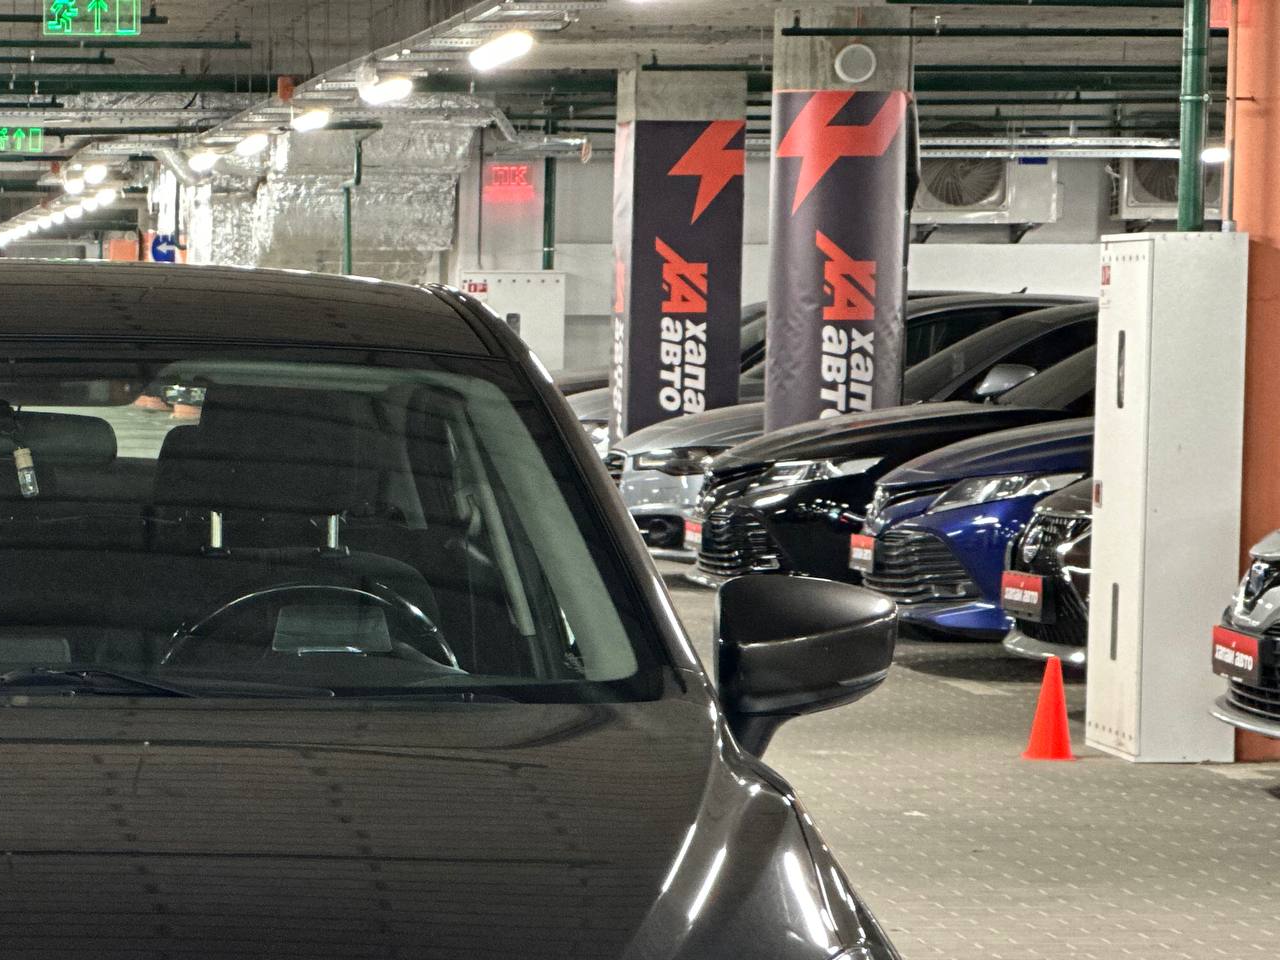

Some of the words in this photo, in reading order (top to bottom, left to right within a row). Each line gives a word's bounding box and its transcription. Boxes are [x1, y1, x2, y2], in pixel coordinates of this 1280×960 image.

[658, 316, 683, 412] авто
[683, 318, 707, 416] хапа
[849, 327, 875, 414] хап
